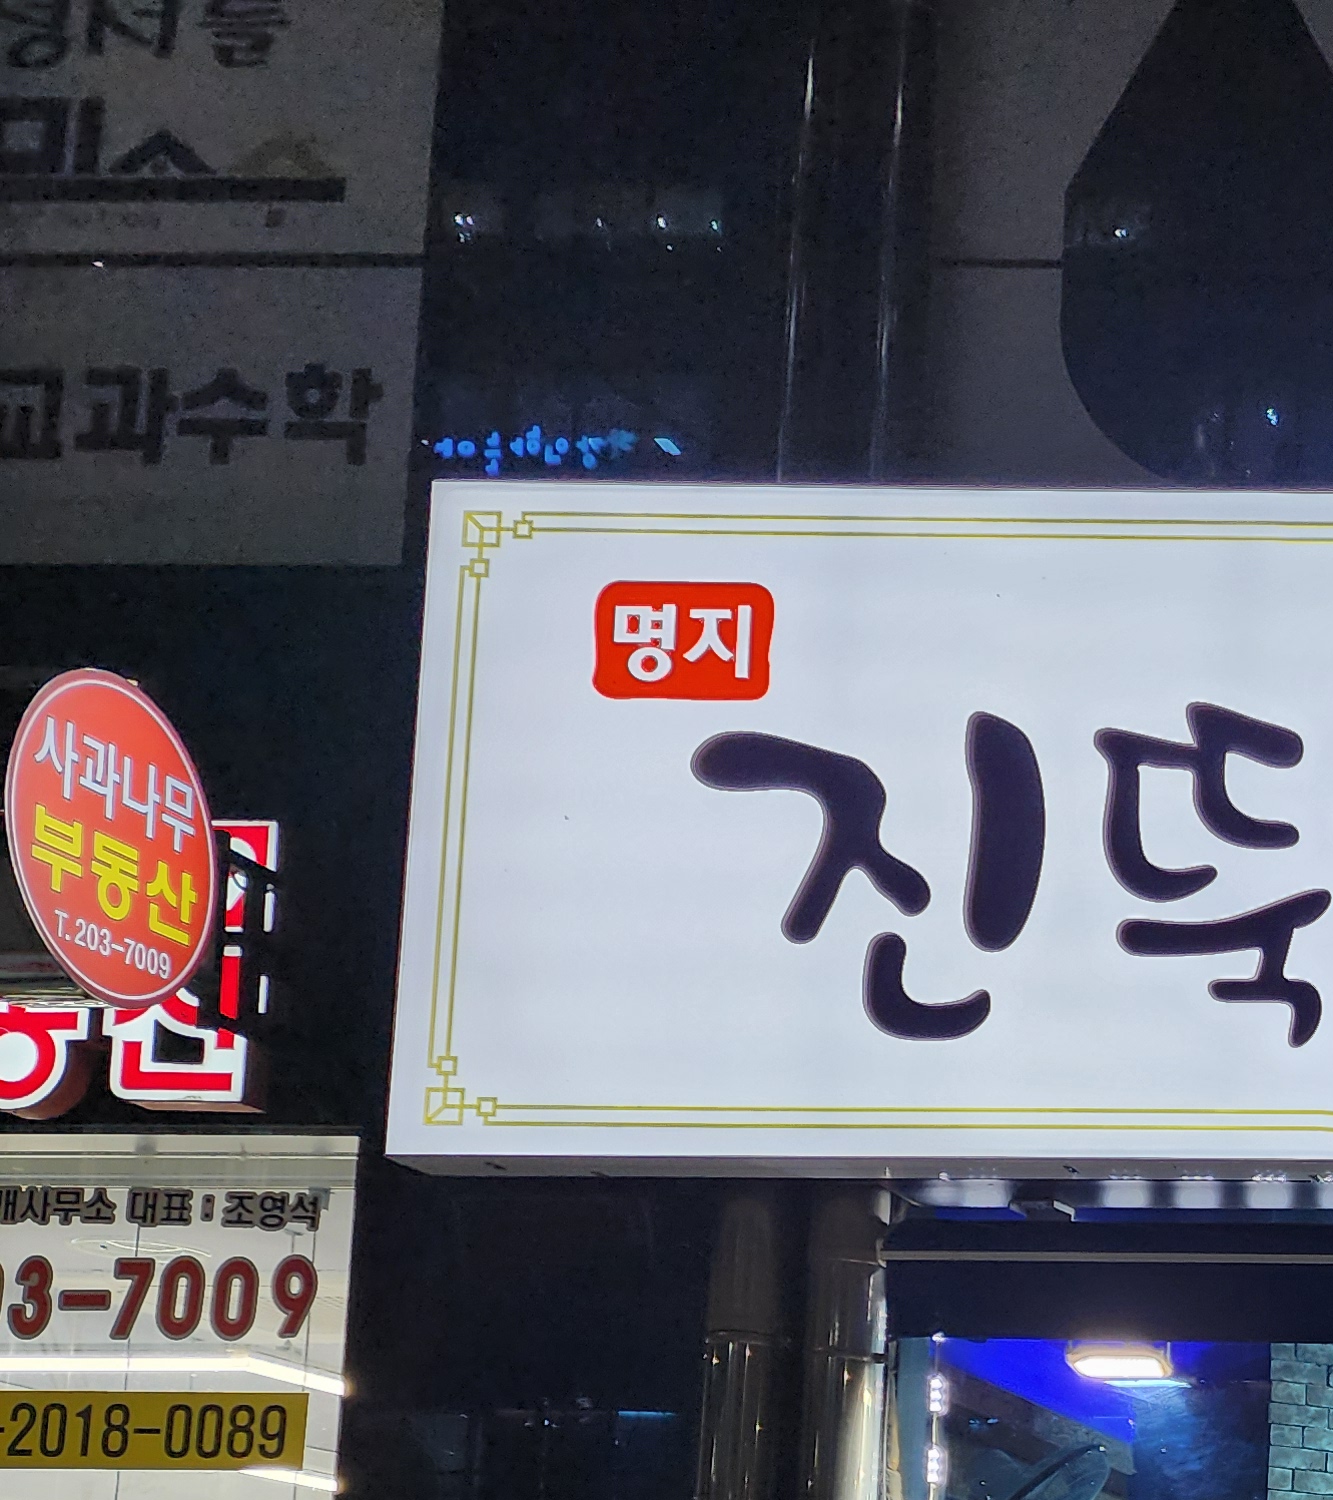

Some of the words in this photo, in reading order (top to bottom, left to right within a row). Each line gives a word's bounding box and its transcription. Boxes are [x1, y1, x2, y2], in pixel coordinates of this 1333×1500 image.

[613, 602, 754, 683] 명지
[34, 715, 195, 852] 사과나무
[31, 803, 197, 948] 부동산
[127, 1188, 192, 1226] 대표
[222, 1192, 321, 1232] 조영석
[0, 1254, 318, 1341] 3-7009
